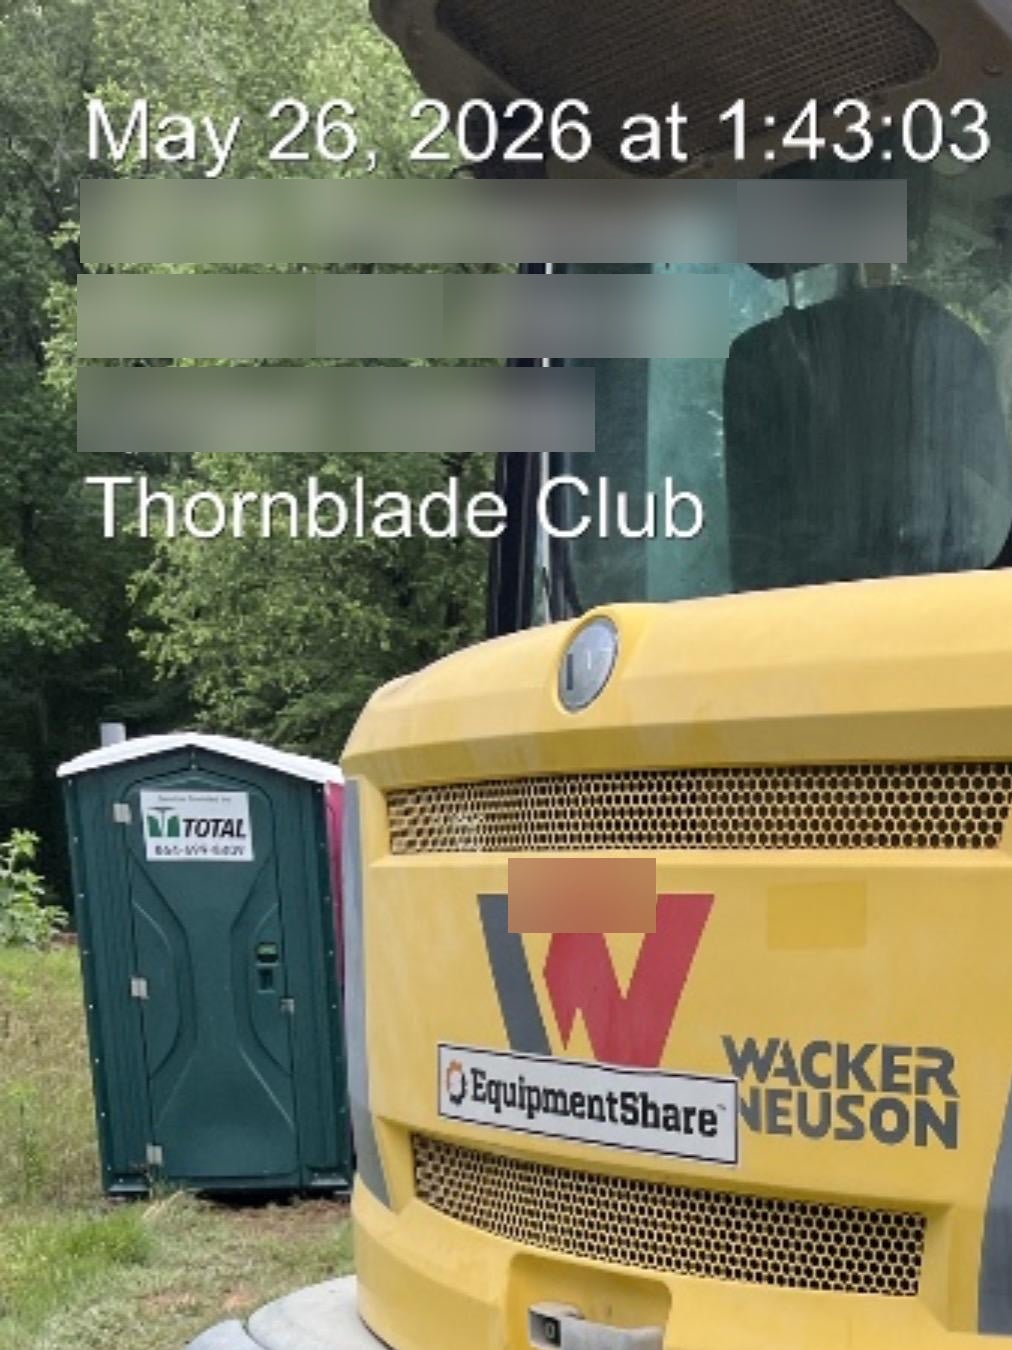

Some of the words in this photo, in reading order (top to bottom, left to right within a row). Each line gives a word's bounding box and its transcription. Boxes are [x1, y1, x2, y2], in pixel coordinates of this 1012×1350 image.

[182, 818, 246, 838] TOTAL
[720, 1035, 959, 1098] WACKER
[470, 1067, 718, 1137] EquipmentShare
